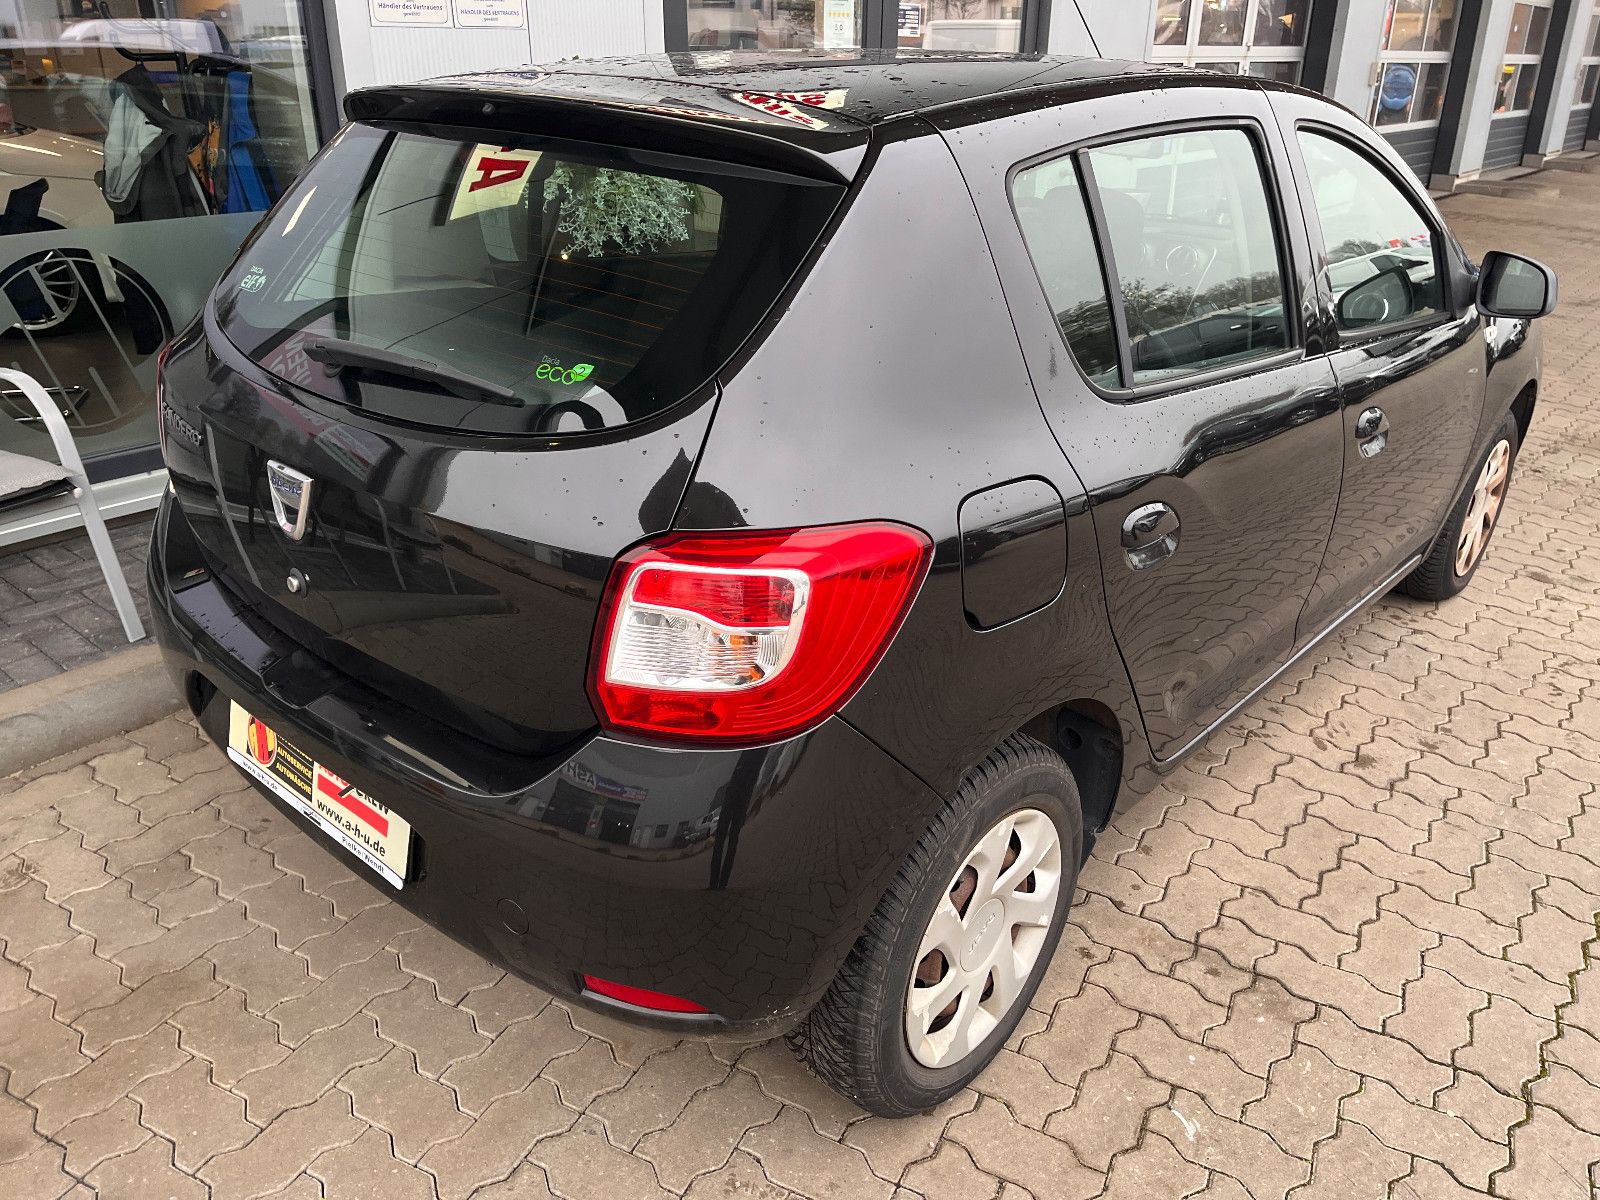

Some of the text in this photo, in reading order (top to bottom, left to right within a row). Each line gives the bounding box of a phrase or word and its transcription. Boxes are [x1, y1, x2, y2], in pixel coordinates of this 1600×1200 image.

[377, 2, 401, 10] Händler
[412, 3, 443, 11] Vertrauens
[541, 354, 561, 366] Dacia
[277, 745, 314, 779] AUTOSERVICE
[316, 798, 387, 858] www.a-h-u.de
